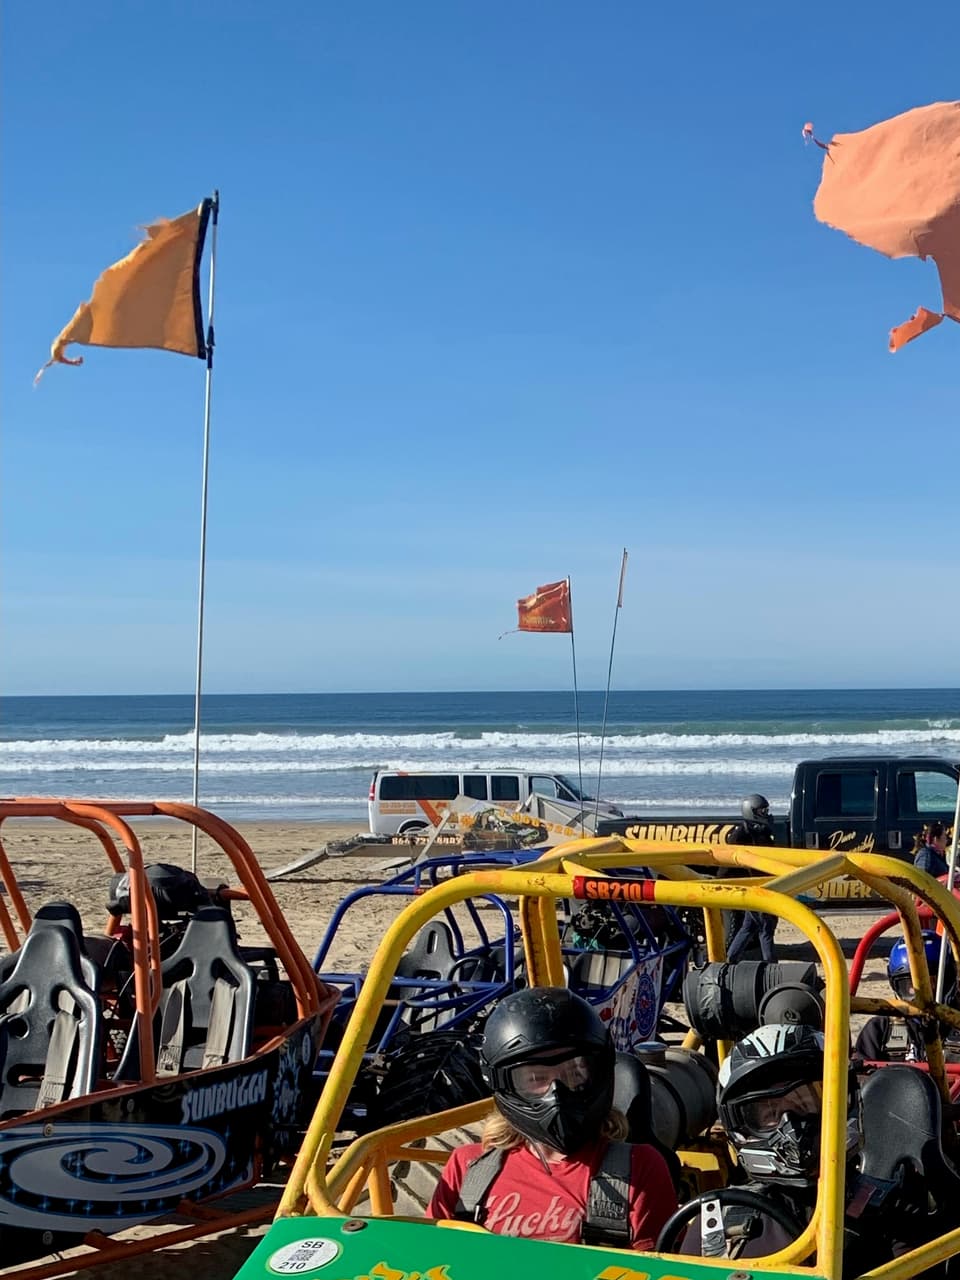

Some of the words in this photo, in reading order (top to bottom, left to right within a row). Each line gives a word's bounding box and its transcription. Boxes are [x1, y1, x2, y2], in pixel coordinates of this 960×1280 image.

[585, 880, 642, 902] SB210
[180, 1067, 270, 1125] SUNBUGGY
[484, 1191, 585, 1241] Lucky
[301, 1240, 325, 1249] SB
[277, 1261, 307, 1271] 210
